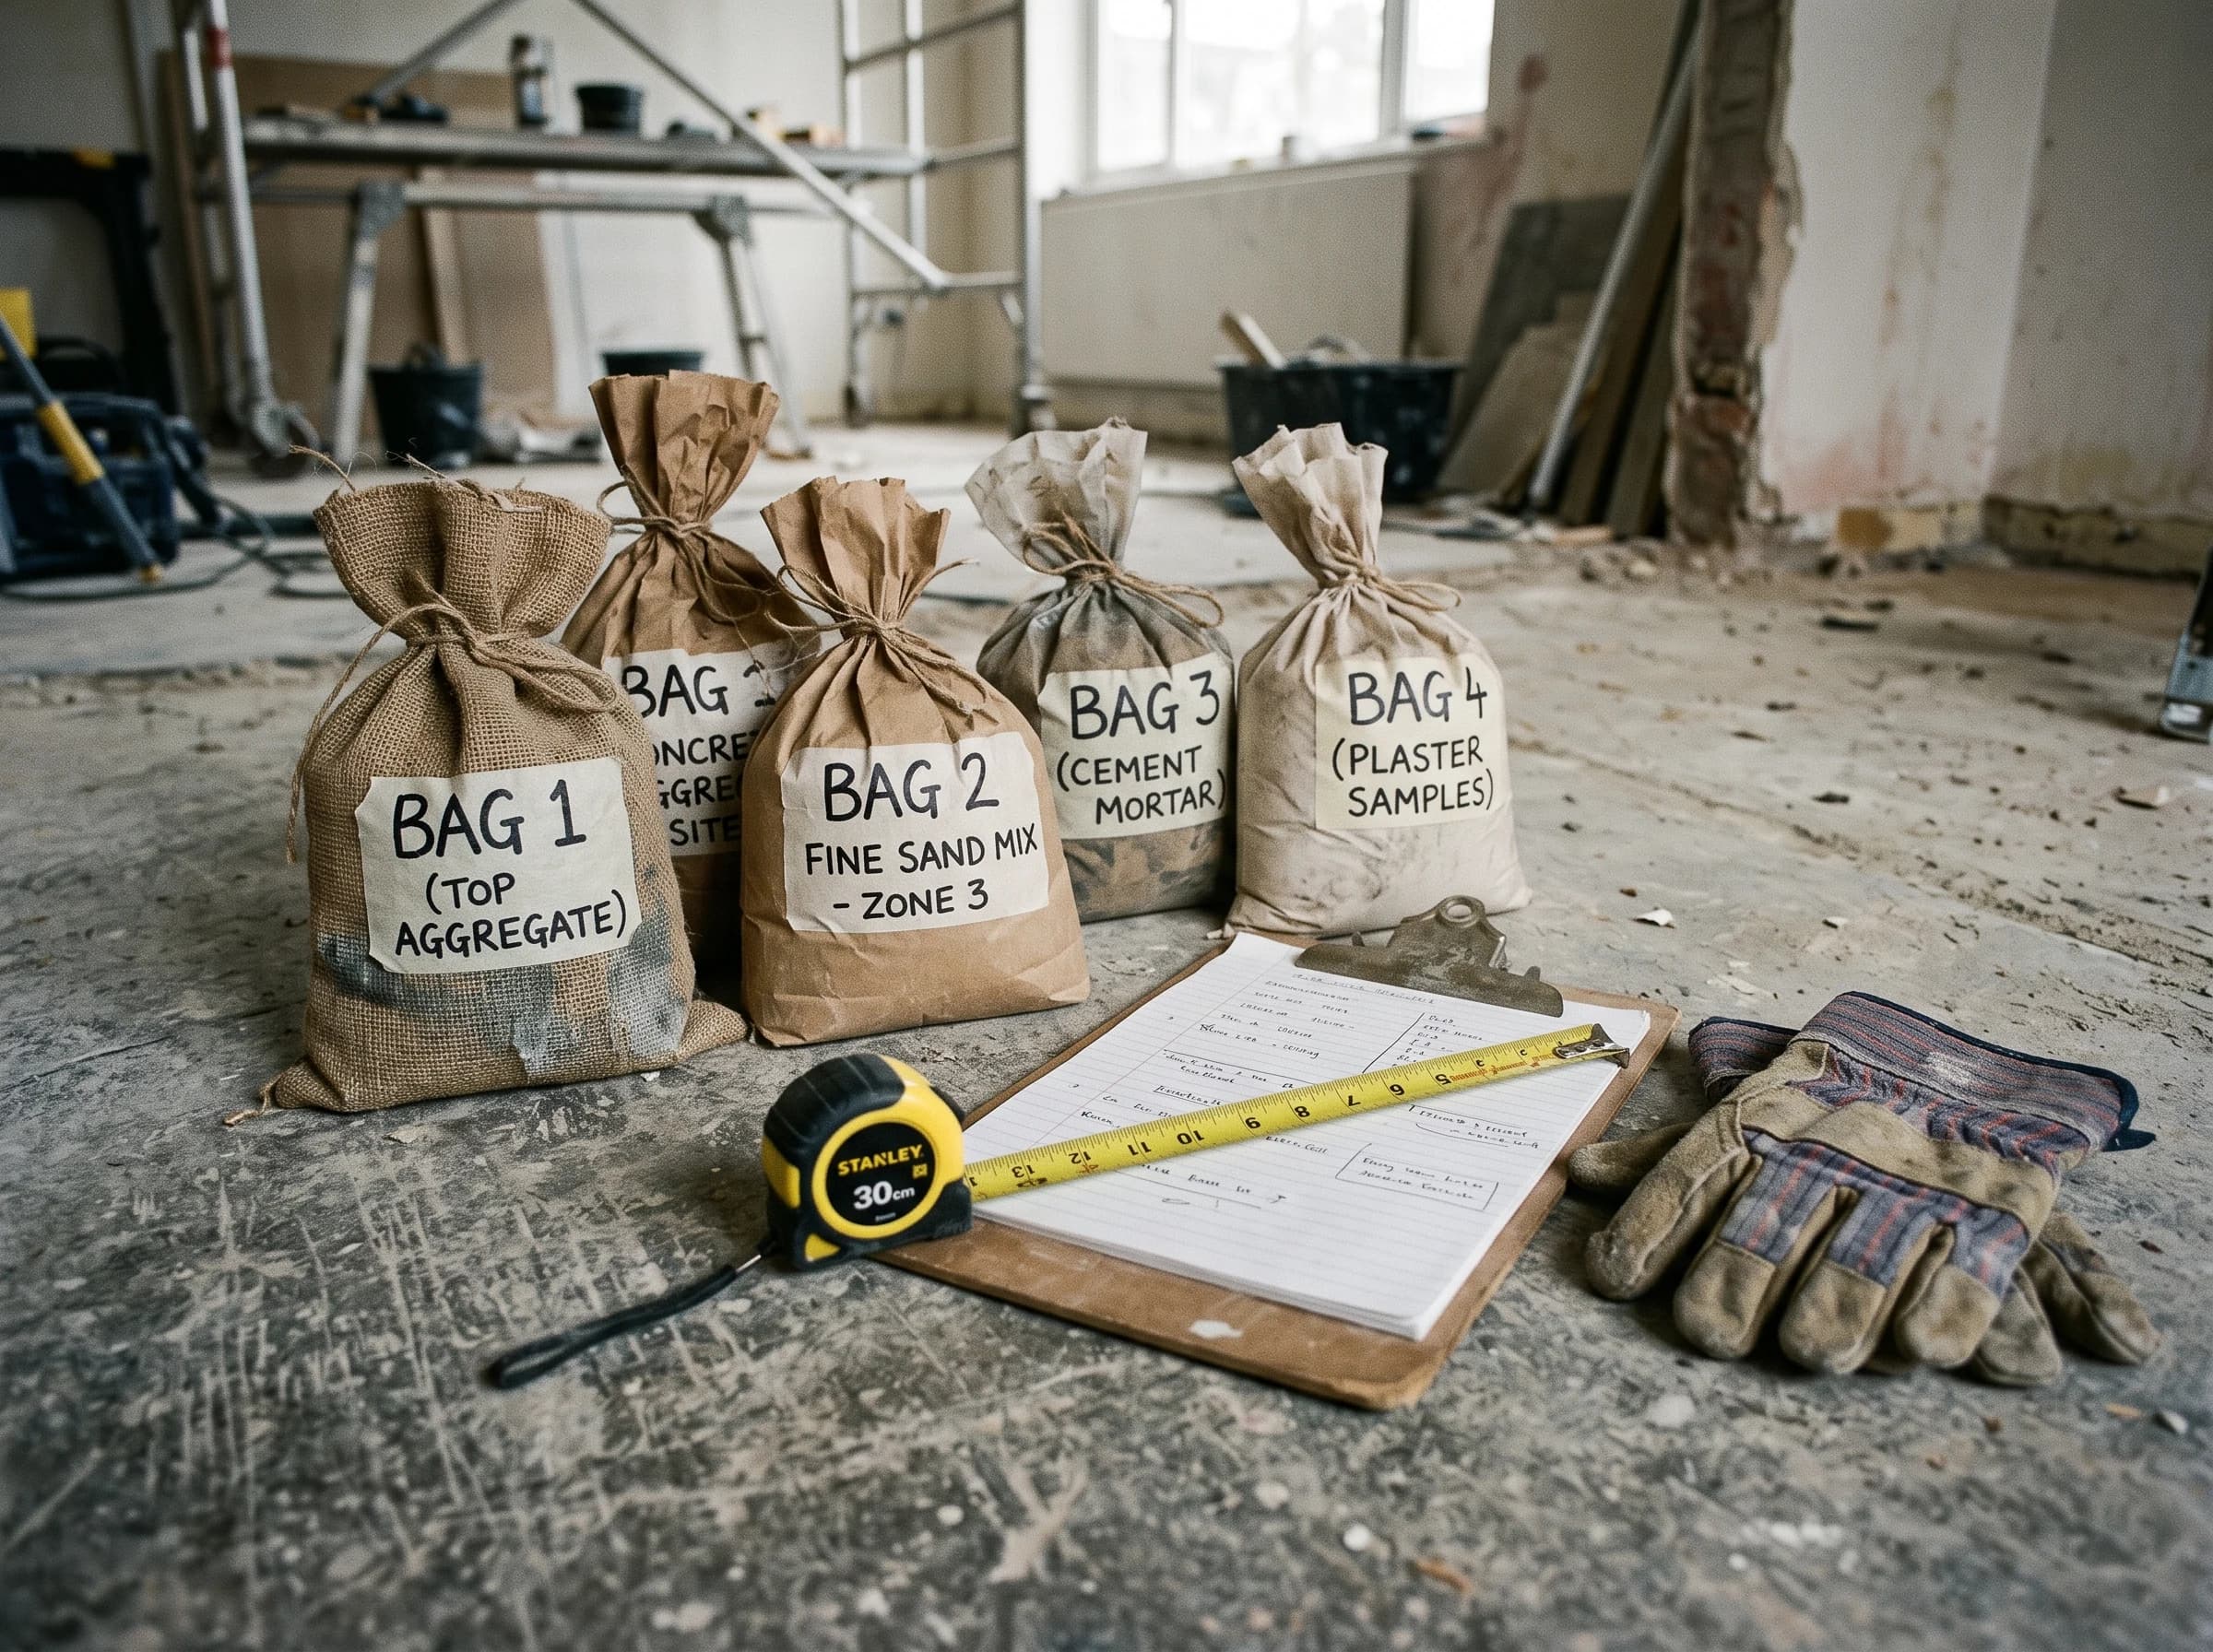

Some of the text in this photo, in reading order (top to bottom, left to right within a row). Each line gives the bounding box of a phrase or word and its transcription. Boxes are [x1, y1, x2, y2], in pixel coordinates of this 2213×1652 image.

[621, 664, 728, 718] BAG
[1070, 670, 1220, 740] BAG 3
[1348, 667, 1487, 726] BAG 4
[653, 730, 760, 766] NCRE
[1056, 745, 1202, 793] (CEMENT
[1331, 735, 1483, 783] (PLASTER
[657, 775, 744, 809] GRE
[823, 752, 1000, 822] BAG 2
[1095, 768, 1226, 825] MORTAR)
[1348, 766, 1493, 818] SAMPLES)
[393, 779, 586, 860] BAG 1
[805, 822, 1037, 876] FINE SAND MIX
[425, 872, 515, 915] (TOP
[861, 885, 954, 920] ZONE
[967, 878, 988, 910] 3
[395, 889, 628, 959] AGGREGATE)
[1294, 1105, 1312, 1120] 8
[1347, 1093, 1361, 1107] 7
[1176, 1129, 1205, 1147] 10
[1245, 1116, 1262, 1130] 9
[837, 1144, 923, 1176] STANLEY
[1068, 1150, 1092, 1165] 12
[1127, 1140, 1153, 1158] 11
[1011, 1164, 1036, 1179] 13
[853, 1180, 916, 1210] 30cm
